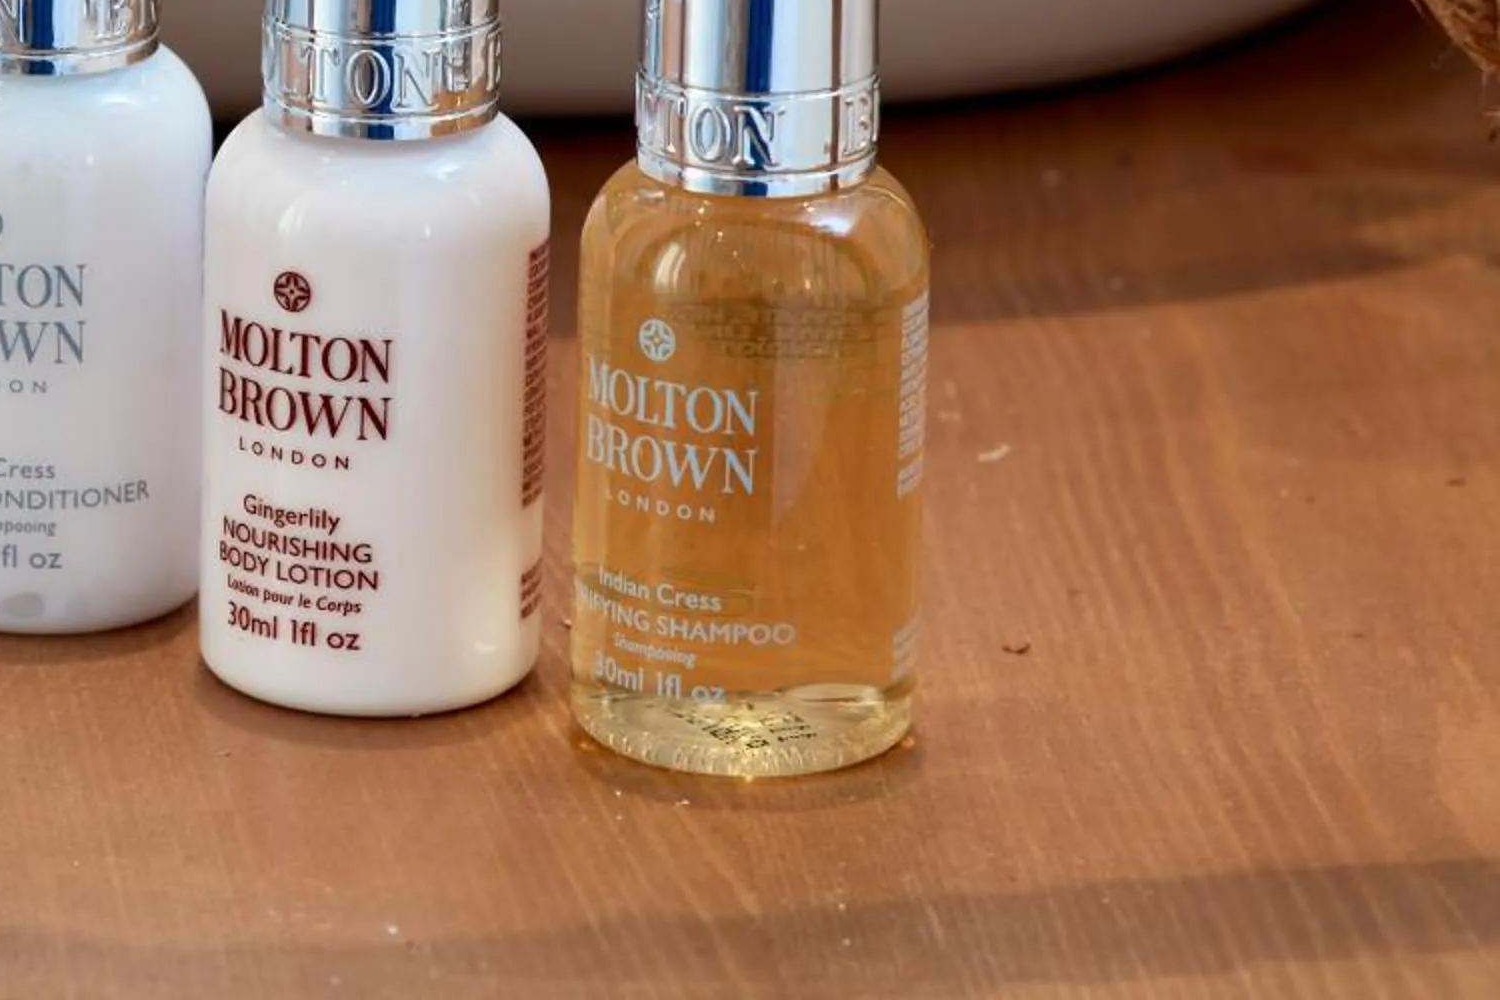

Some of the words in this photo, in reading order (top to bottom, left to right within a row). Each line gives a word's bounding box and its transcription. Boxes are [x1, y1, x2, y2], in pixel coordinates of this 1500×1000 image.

[220, 308, 393, 384] MOLTON
[218, 365, 392, 441] BROWN
[588, 354, 759, 438] MOLTON
[239, 436, 351, 470] LONDON
[587, 412, 758, 496] BROWN
[243, 493, 340, 536] Gingerlily
[604, 488, 716, 524] LONDON
[28, 552, 62, 570] oz
[222, 515, 374, 564] NOURISHING
[219, 539, 269, 577] BODY
[276, 560, 380, 592] LOTION
[227, 573, 260, 598] Lotion
[263, 588, 295, 605] pour
[298, 592, 312, 609] le
[316, 596, 362, 617] Corps
[598, 566, 650, 600] Indian
[656, 583, 724, 613] Cress
[227, 601, 278, 641] 30ml
[291, 619, 316, 647] 1fl
[326, 632, 361, 651] oz
[656, 614, 797, 646] SHAMPOO
[594, 651, 644, 693] 30ml
